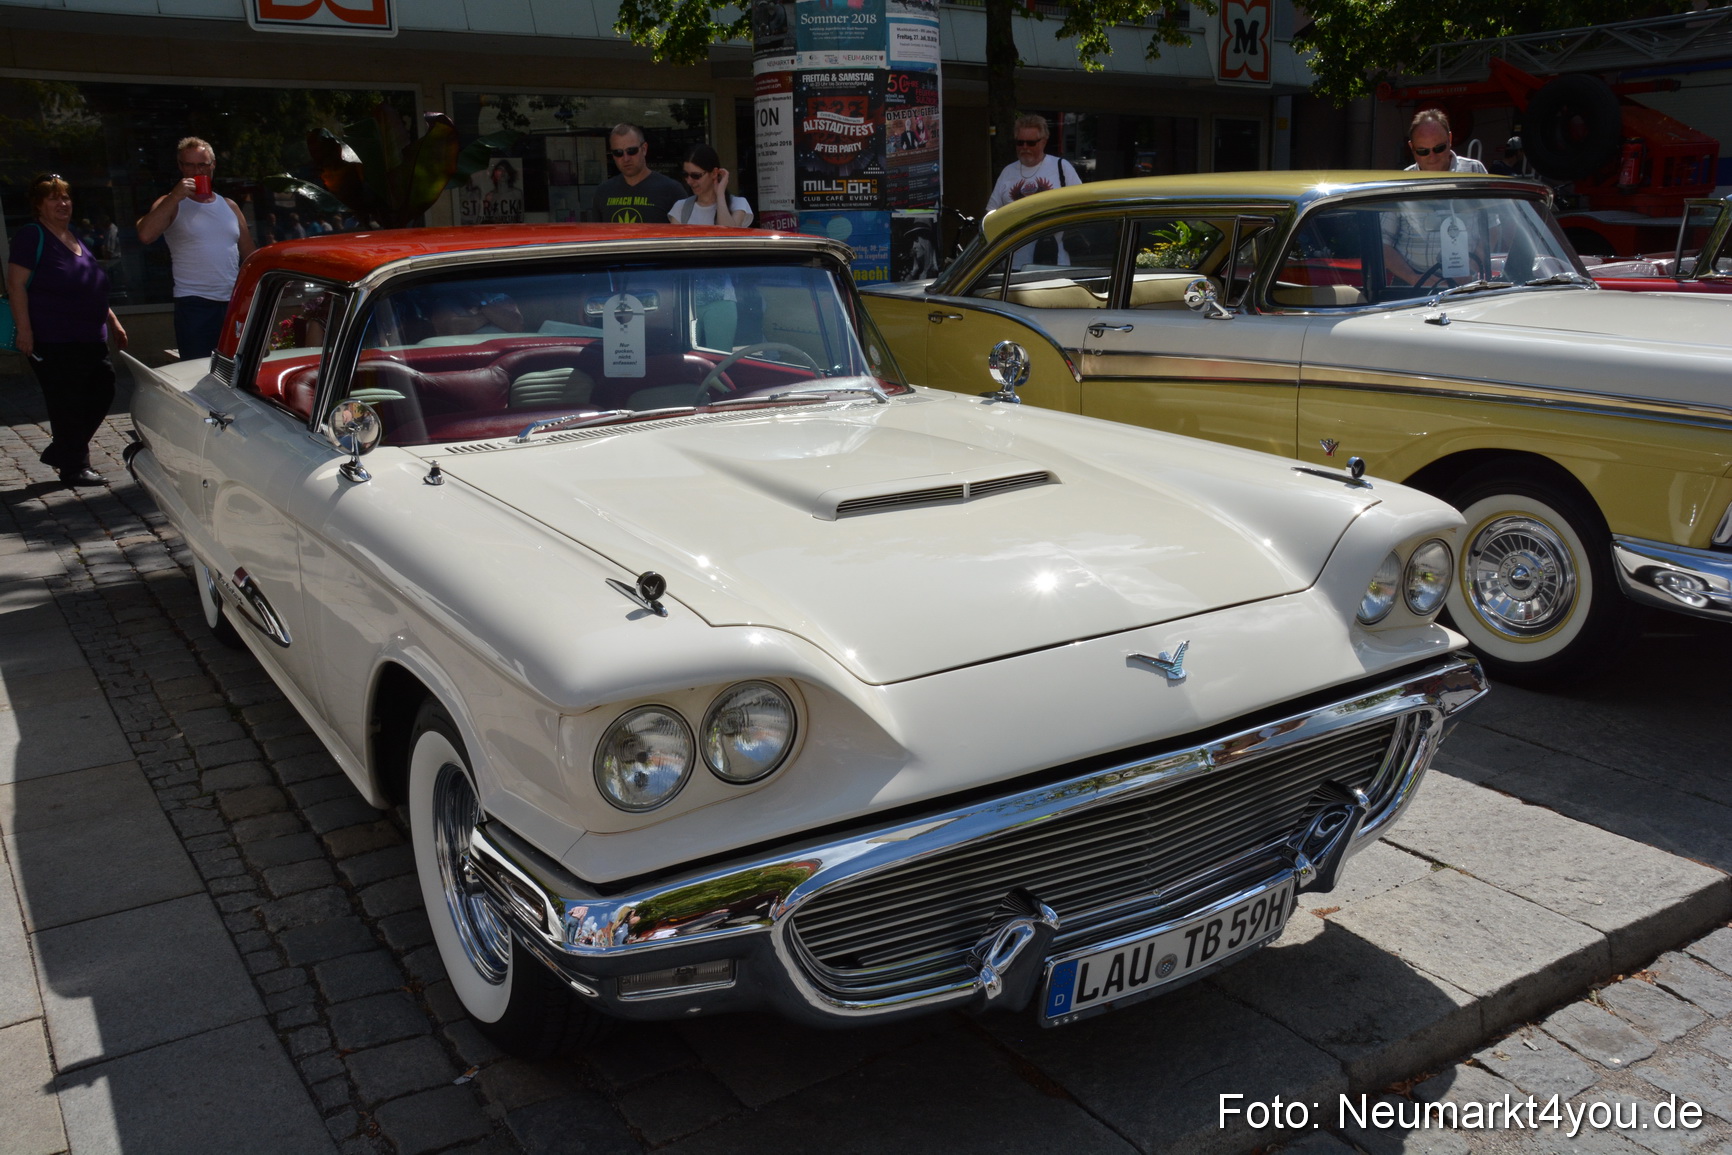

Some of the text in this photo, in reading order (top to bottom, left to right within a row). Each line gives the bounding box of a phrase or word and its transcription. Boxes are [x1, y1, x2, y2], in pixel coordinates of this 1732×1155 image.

[800, 13, 877, 25] Sommer 2018
[1233, 18, 1259, 55] M
[802, 72, 874, 83] FREITAG & SAMSTAG
[803, 119, 874, 136] ALTSTADTFEST
[814, 142, 862, 153] AFTER PARTY
[607, 196, 633, 206] EINFACH
[776, 216, 797, 230] DEIN
[853, 265, 889, 281] nacht
[1076, 887, 1288, 1004] LAU TB 59H
[1054, 993, 1065, 1007] D
